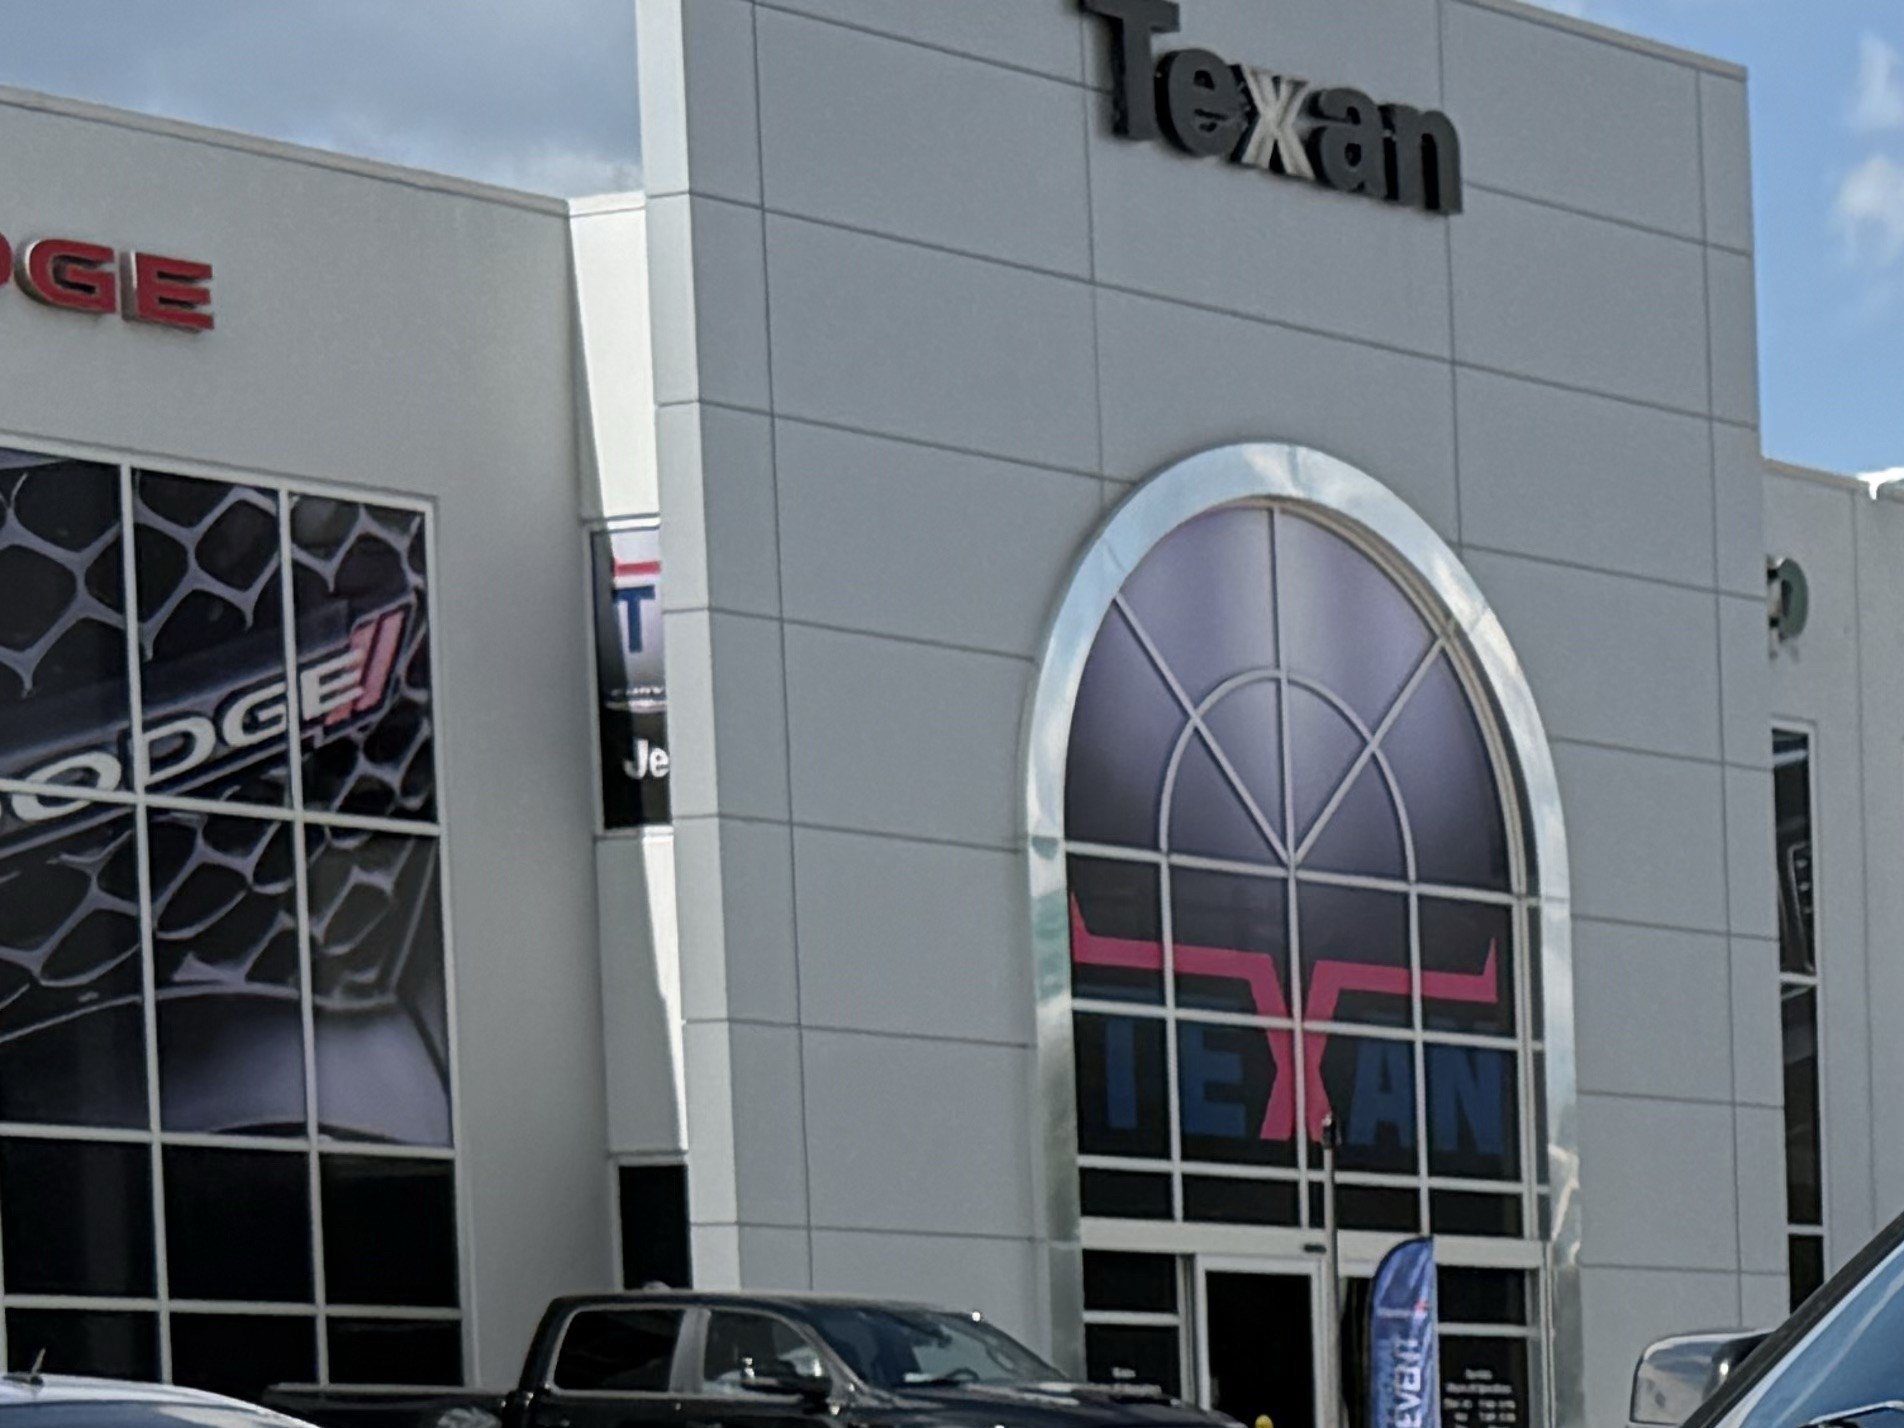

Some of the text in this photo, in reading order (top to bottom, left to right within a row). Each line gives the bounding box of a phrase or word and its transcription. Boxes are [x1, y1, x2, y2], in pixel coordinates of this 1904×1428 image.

[1083, 0, 1463, 214] Texan
[0, 232, 214, 334] GE
[0, 648, 365, 822] ODGE
[1070, 892, 1503, 1156] TEXAN
